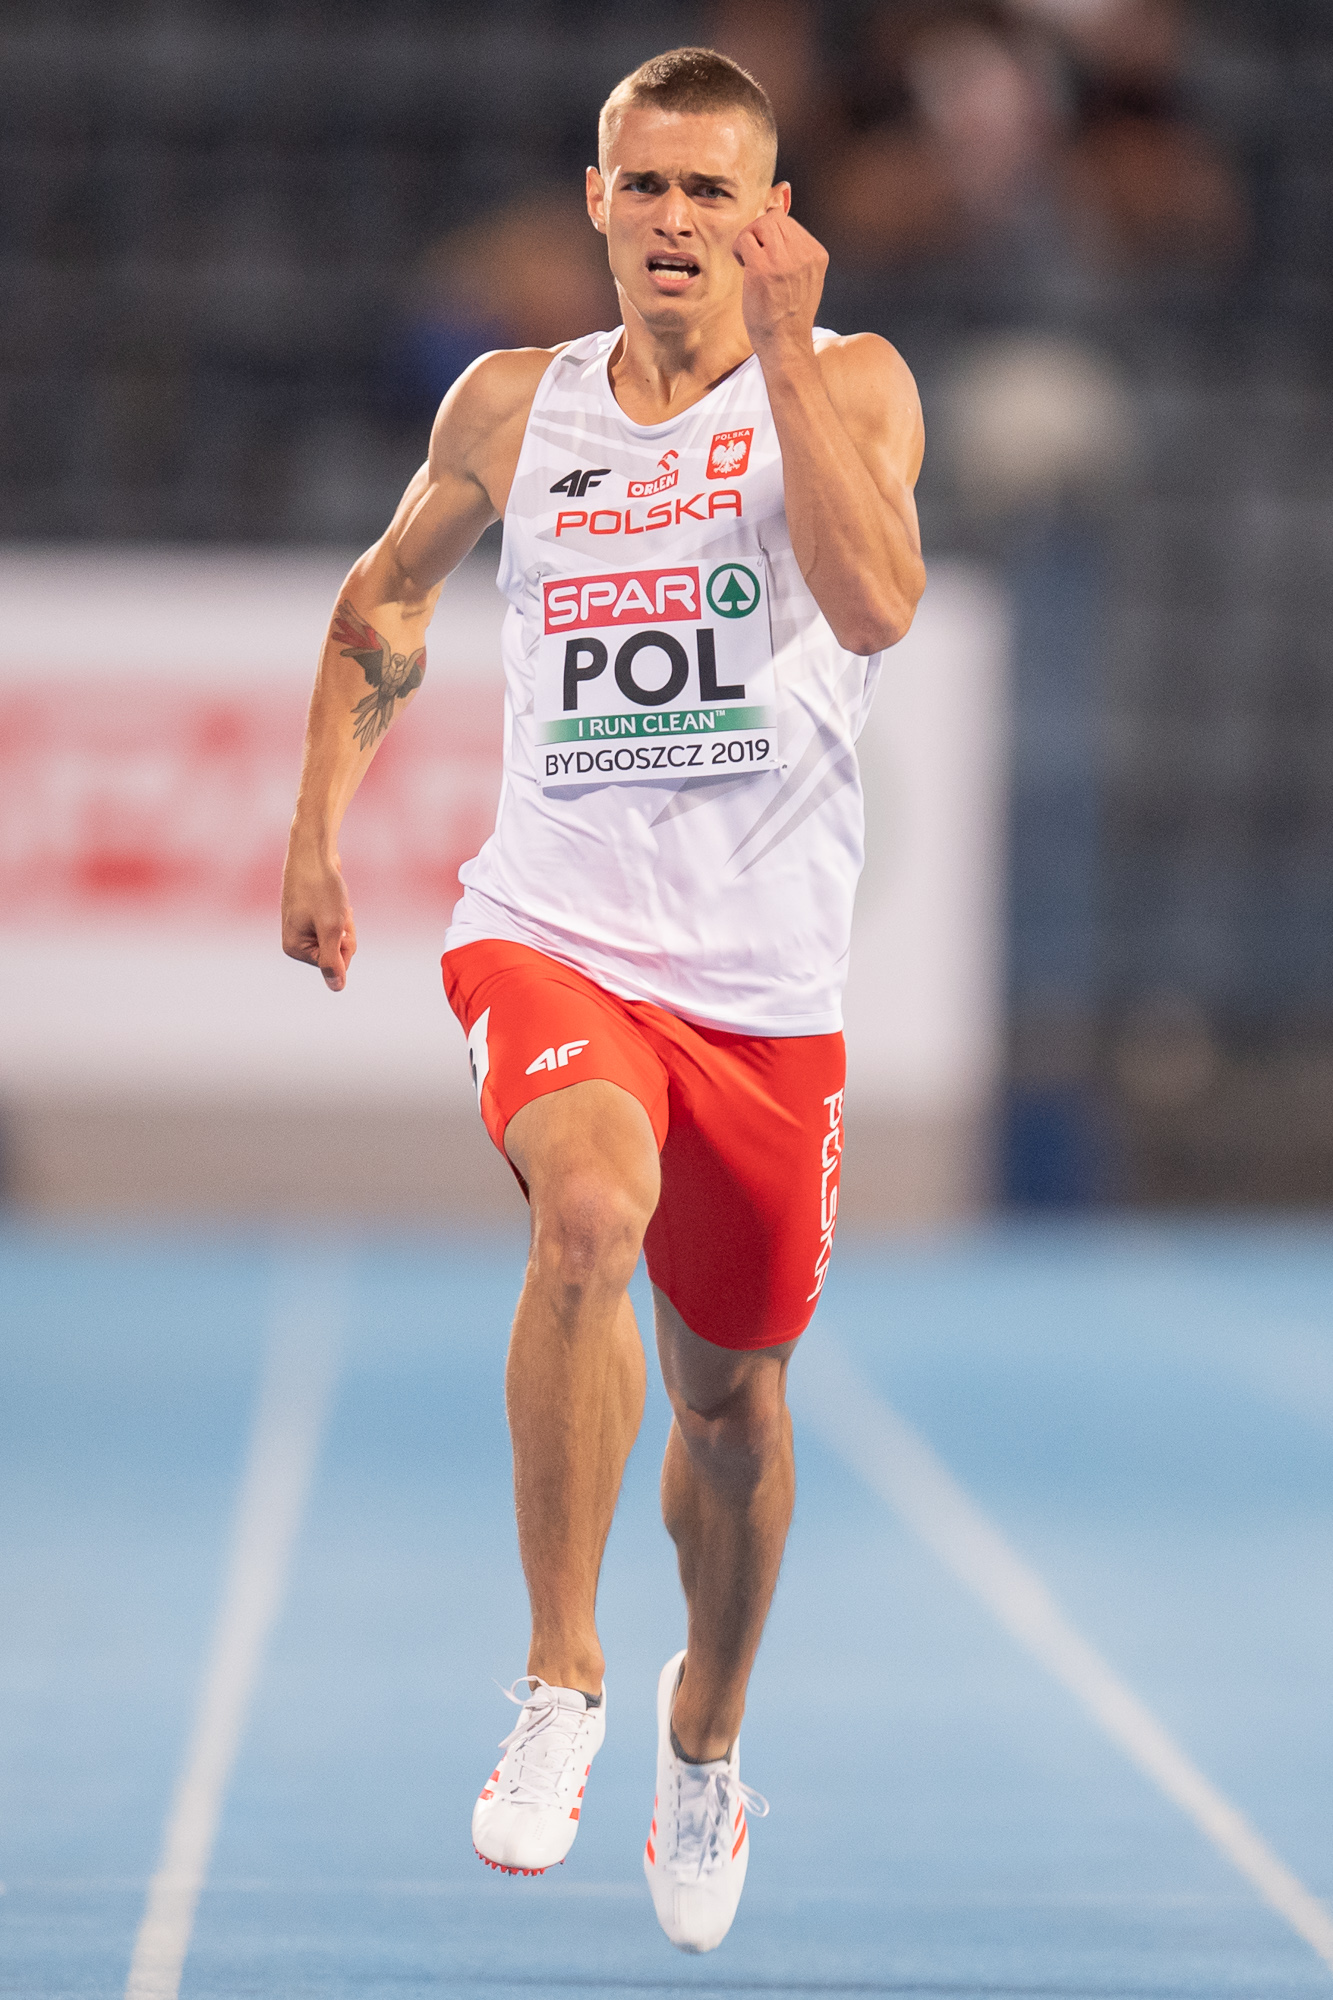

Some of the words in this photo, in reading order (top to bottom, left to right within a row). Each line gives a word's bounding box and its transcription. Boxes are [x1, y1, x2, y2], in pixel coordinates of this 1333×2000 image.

[714, 430, 751, 442] POLSKA
[549, 469, 612, 497] 4F
[630, 472, 676, 496] ORLEN
[555, 489, 742, 537] POLSKA
[547, 574, 697, 626] SPAR
[563, 628, 745, 711] POL
[578, 720, 584, 738] I
[590, 716, 636, 737] RUN
[545, 744, 703, 776] BYDGOSZCZ
[711, 738, 770, 765] 2019
[525, 1039, 590, 1075] 4F
[806, 1087, 844, 1303] POLSKA
